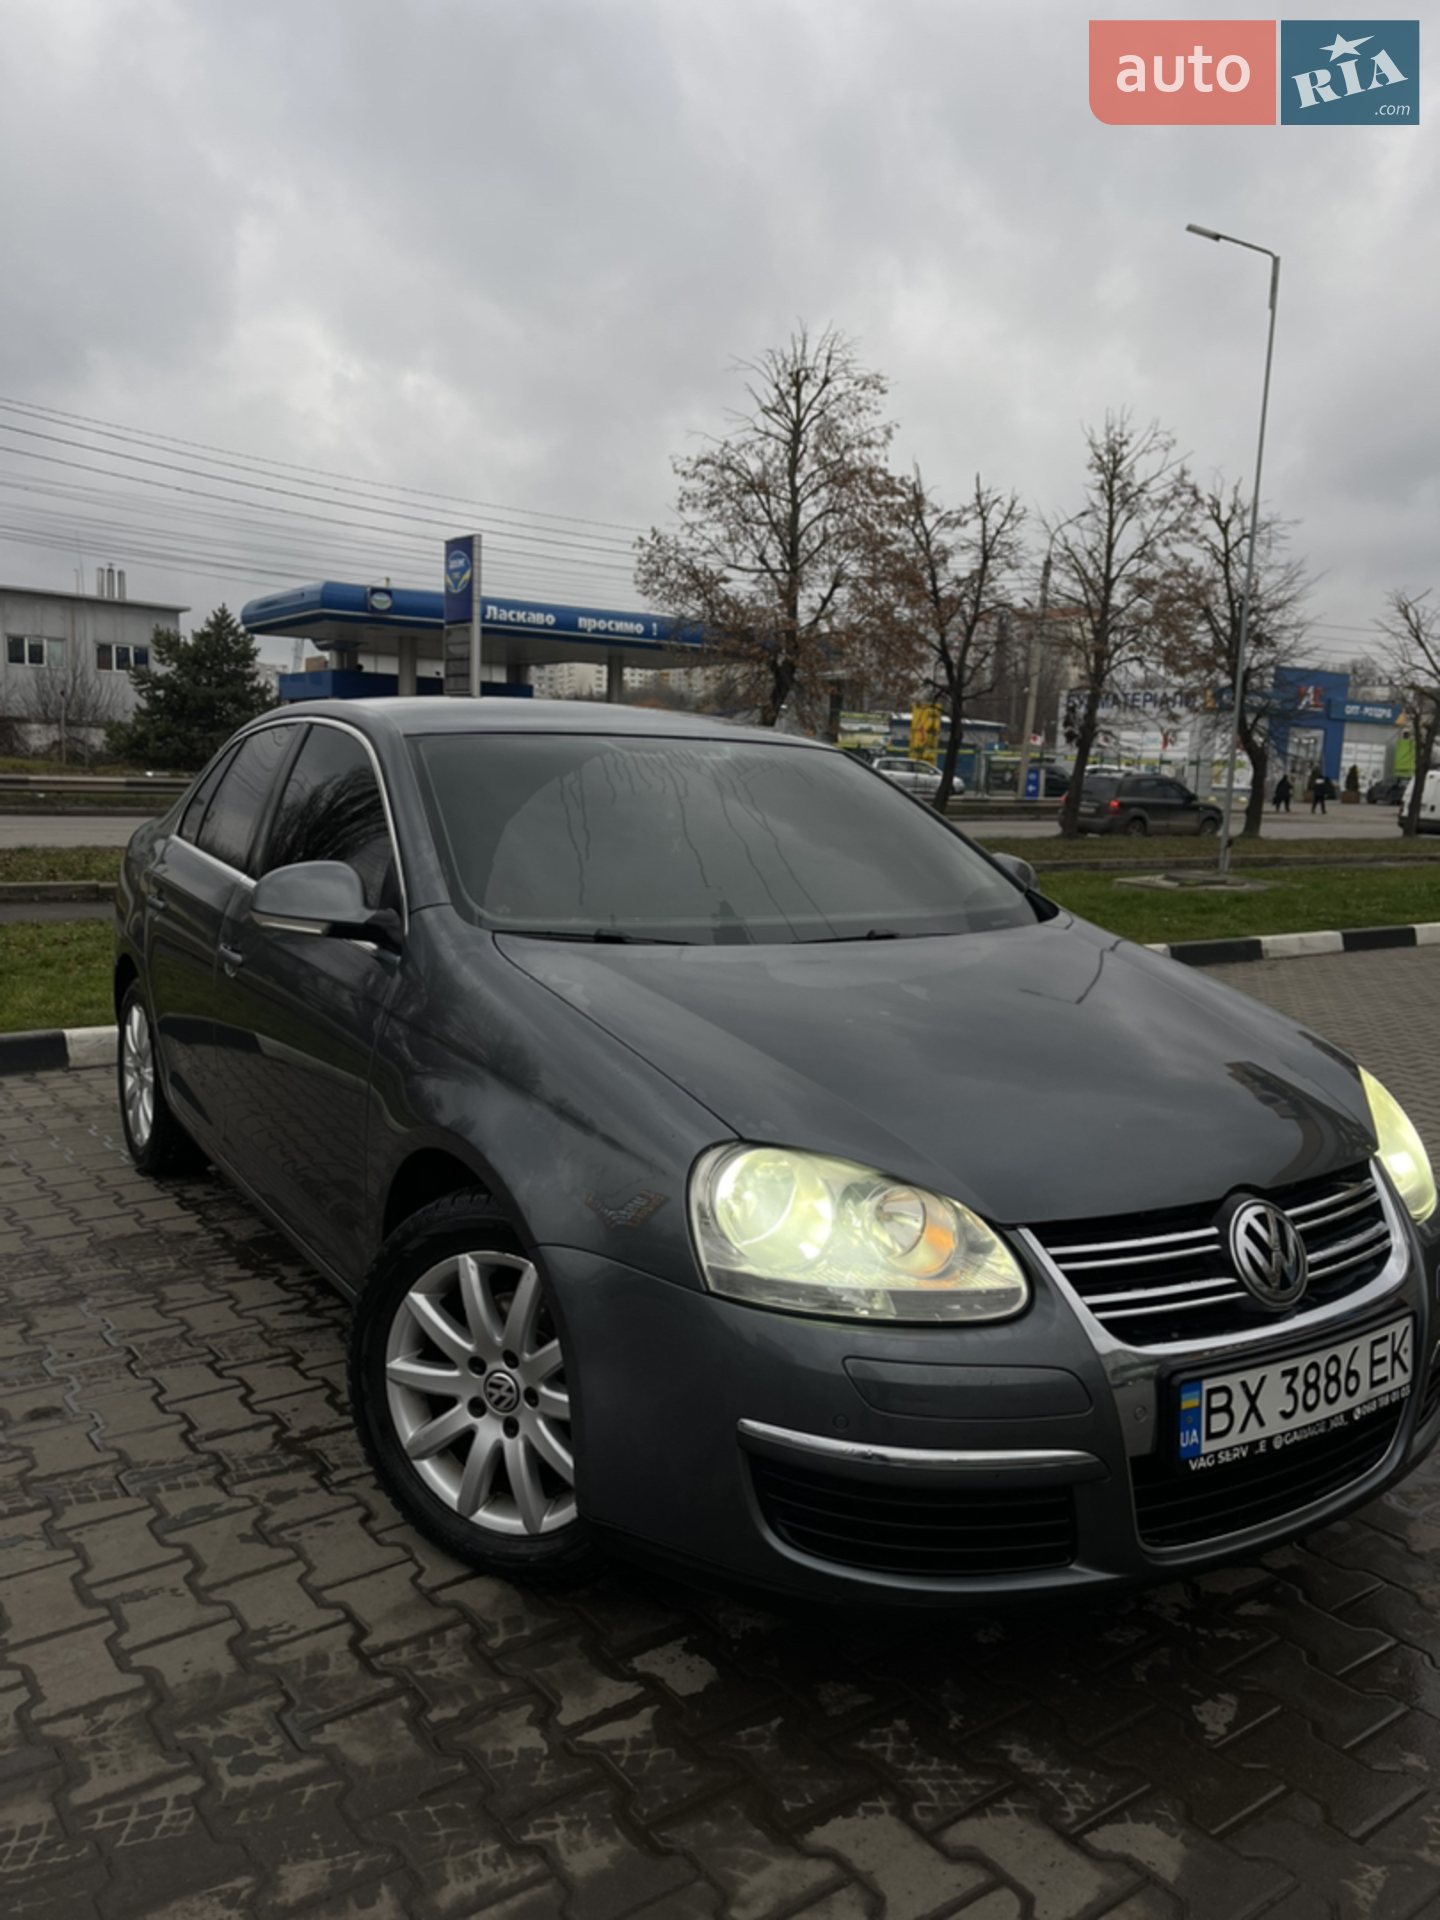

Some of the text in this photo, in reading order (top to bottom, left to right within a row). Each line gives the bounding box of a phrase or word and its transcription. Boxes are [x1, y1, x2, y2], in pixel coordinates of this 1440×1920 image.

[485, 605, 555, 626] Ласкаво
[578, 616, 644, 635] просимо
[1205, 1326, 1409, 1441] BX 3886 EK
[1180, 1429, 1199, 1448] UA
[1189, 1454, 1215, 1471] VAG
[1217, 1440, 1266, 1464] SERVE
